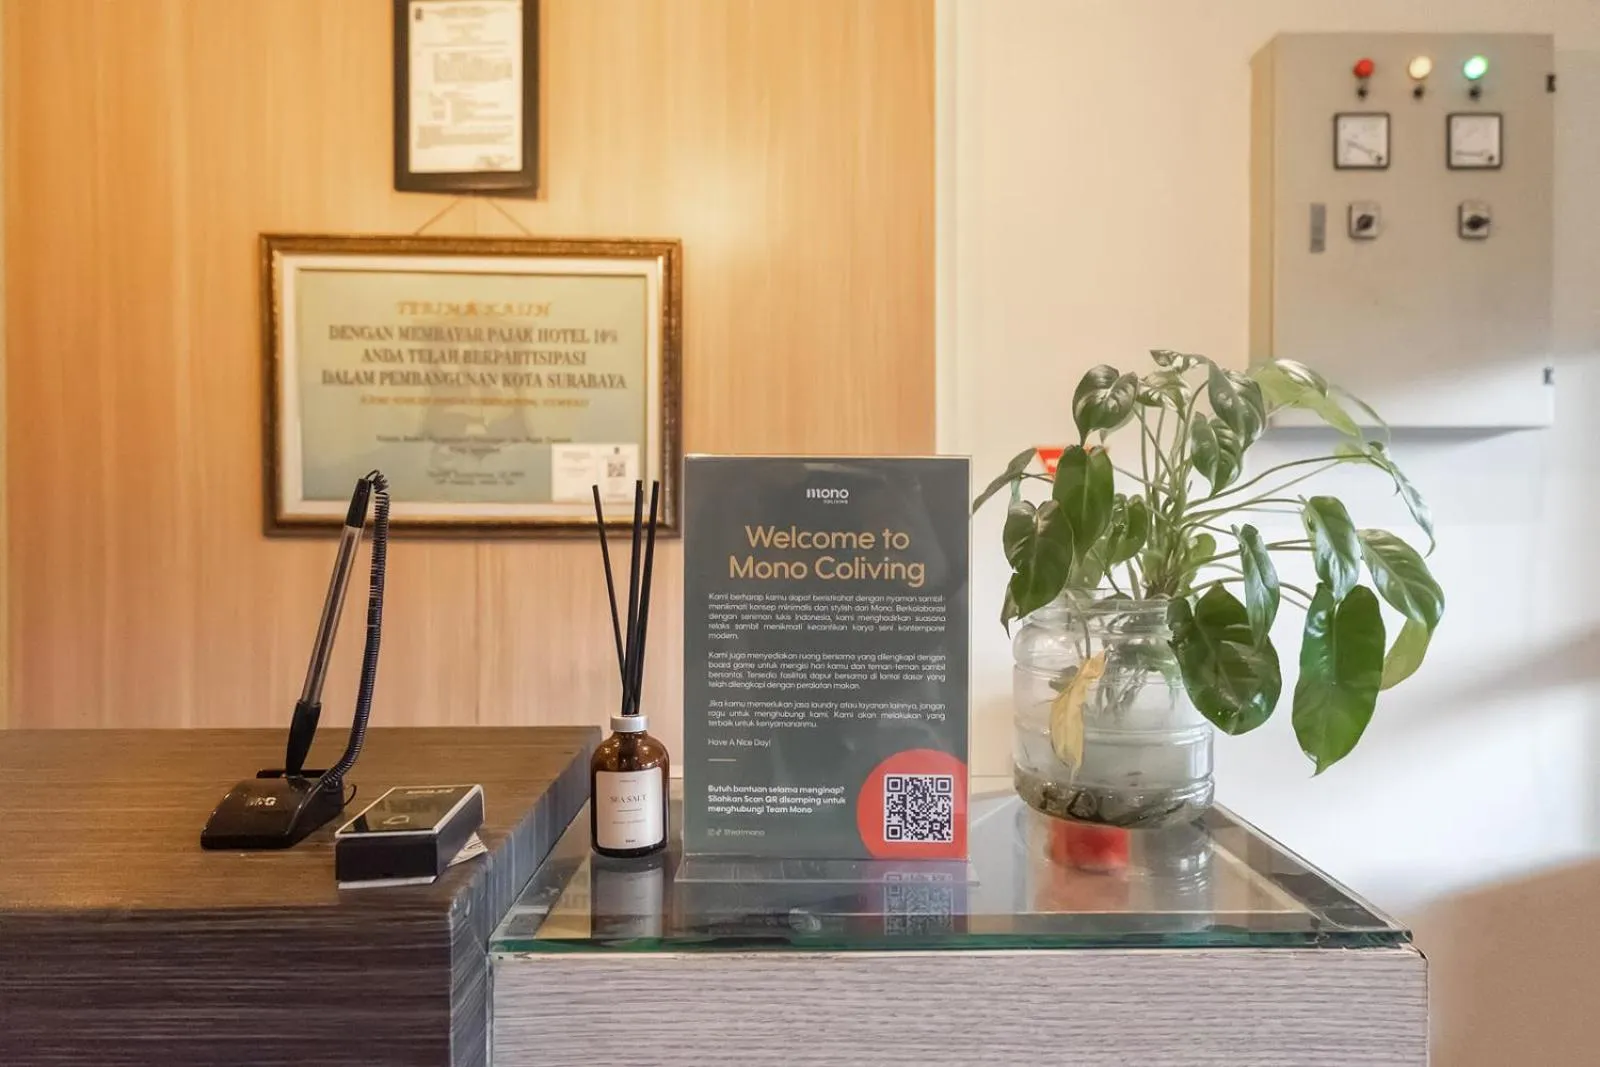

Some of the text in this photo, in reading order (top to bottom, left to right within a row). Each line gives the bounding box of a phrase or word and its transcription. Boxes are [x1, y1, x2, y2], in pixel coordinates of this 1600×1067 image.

[328, 325, 393, 341] DENGAN
[398, 326, 482, 342] MEMBAYAR
[488, 327, 533, 343] PAJAK
[537, 328, 590, 344] HOTEL
[361, 348, 587, 366] ANDA TELAH BERPARTISIPASI
[321, 369, 627, 389] DALAM PEMBANGUNAN KOTA SURABAYA
[745, 525, 910, 550] Welcome to
[729, 555, 925, 588] Mono Coliving
[708, 593, 729, 601] Kami
[730, 594, 764, 603] berharap
[855, 595, 885, 604] dengan
[750, 604, 776, 612] konsep
[831, 605, 852, 613] stylish
[708, 614, 738, 622] dengan
[858, 614, 912, 624] menghadirkan
[852, 624, 874, 632] karya
[729, 653, 746, 661] juga
[747, 652, 797, 661] menyediakan
[857, 654, 876, 662] yang
[809, 672, 832, 681] dapur
[926, 674, 946, 682] yang
[728, 681, 766, 689] dilengkapi
[766, 682, 796, 690] dengan
[797, 682, 832, 690] peralatan
[793, 701, 810, 709] jasa
[811, 702, 838, 710] laundry
[919, 703, 946, 711] jangan
[754, 711, 806, 720] menghubungi
[857, 711, 877, 719] akan
[926, 713, 946, 721] yang
[753, 739, 771, 748] Day!
[708, 785, 845, 795] Butuh bantuan selama menginap?
[708, 795, 846, 805] Silahkan Scan QR disamping untuk
[708, 805, 764, 815] menghubungi
[766, 805, 788, 813] Team
